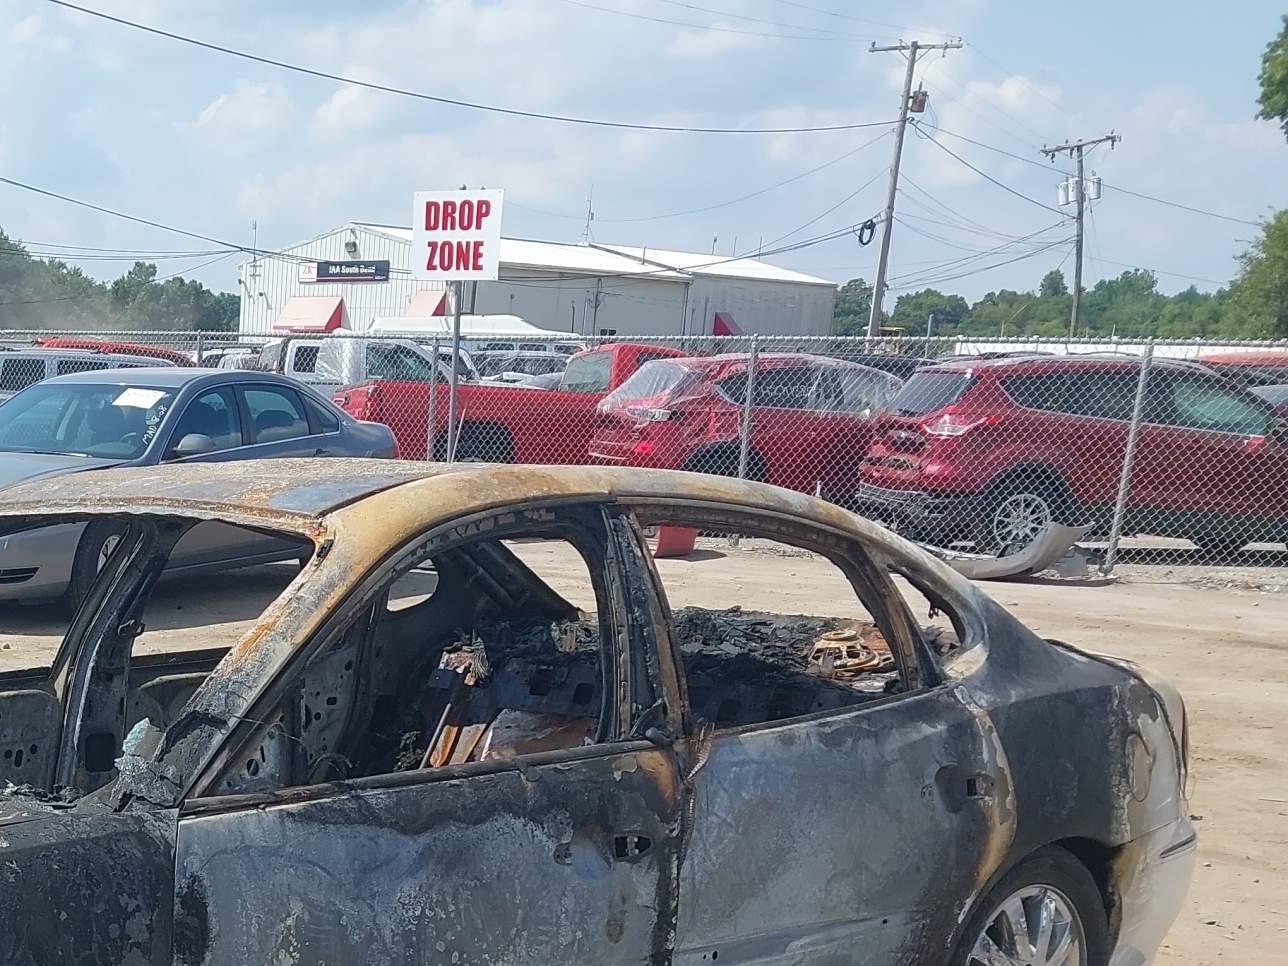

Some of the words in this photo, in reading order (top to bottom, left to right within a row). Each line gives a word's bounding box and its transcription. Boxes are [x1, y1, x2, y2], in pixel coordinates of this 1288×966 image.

[425, 199, 491, 231] DROP
[341, 265, 359, 274] South
[426, 240, 484, 271] ZONE
